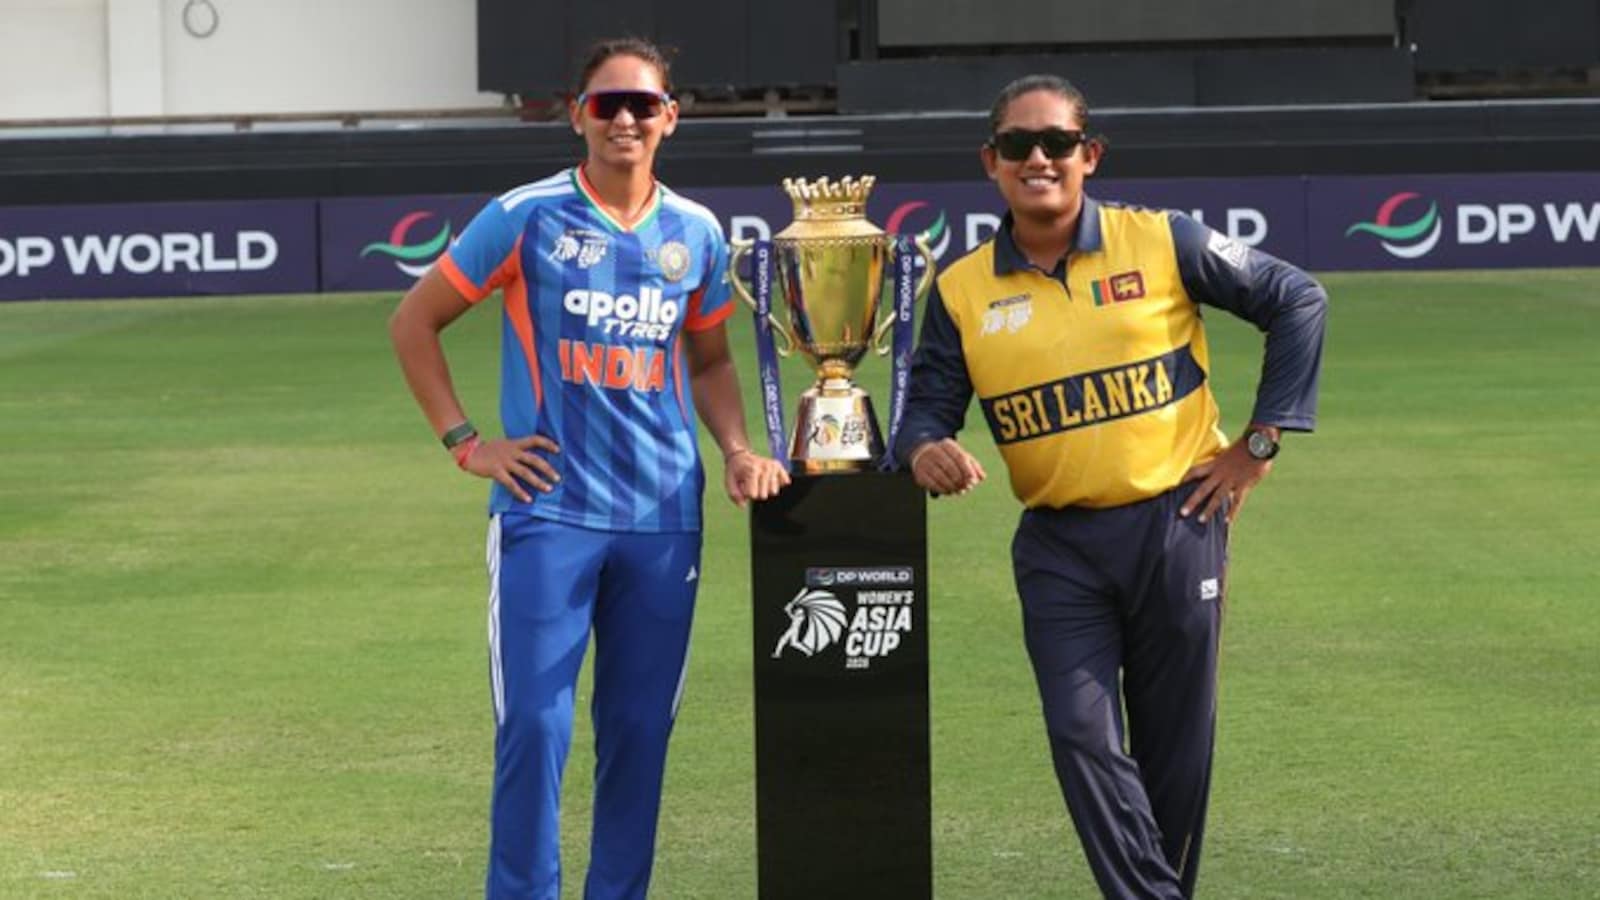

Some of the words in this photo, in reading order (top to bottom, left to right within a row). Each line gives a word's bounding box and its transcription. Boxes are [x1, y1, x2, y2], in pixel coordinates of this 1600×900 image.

[1457, 204, 1536, 243] DP
[62, 231, 278, 275] WORLD
[759, 248, 769, 295] WORLD
[901, 256, 912, 275] DP
[564, 286, 678, 326] apollo
[900, 275, 912, 322] WORLD
[604, 319, 673, 341] TYRES
[558, 339, 665, 392] INDIA
[994, 389, 1052, 440] SRI
[1053, 360, 1174, 428] LANKA
[837, 572, 858, 582] DP
[859, 571, 910, 581] WORLD
[857, 591, 914, 604] WOMEN'S
[850, 606, 913, 631] ASIA
[845, 632, 901, 656] CUP
